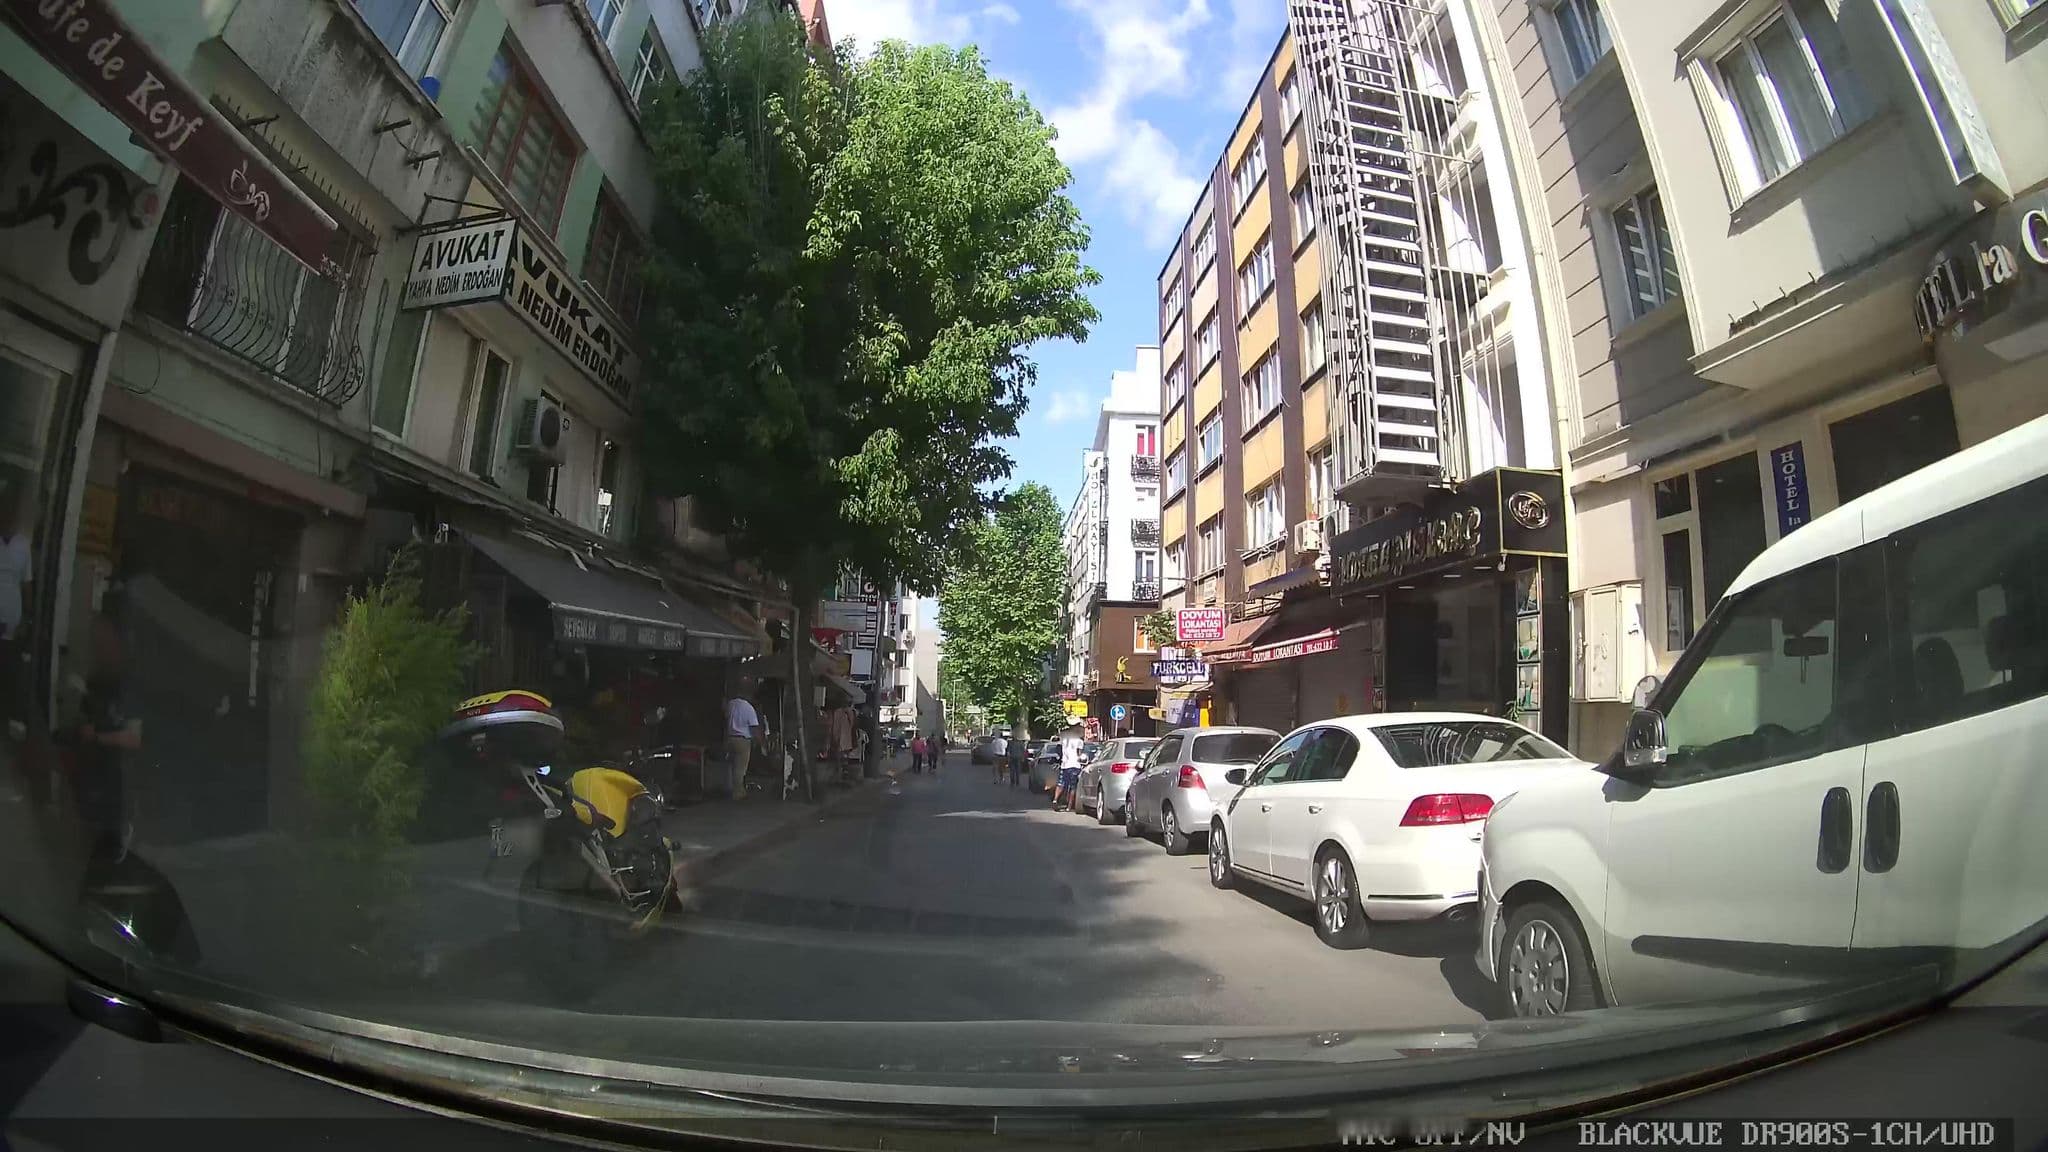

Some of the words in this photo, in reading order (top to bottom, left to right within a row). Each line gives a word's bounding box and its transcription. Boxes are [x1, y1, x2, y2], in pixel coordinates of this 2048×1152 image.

[38, 0, 89, 43] afe
[88, 32, 124, 80] de
[126, 71, 203, 151] Keyf
[419, 229, 505, 273] AVUKAT
[408, 278, 432, 299] YAHYA
[435, 271, 460, 296] NEDİM
[462, 264, 503, 292] ERDOĞAN
[513, 237, 631, 366] VUKAT
[517, 280, 573, 348] NEDİM
[1780, 449, 1800, 511] HOTEL
[1181, 610, 1221, 620] DOYUM
[1181, 619, 1221, 629] LOKANTASI
[1153, 661, 1205, 674] TURKCELL
[1274, 643, 1303, 660] LOKANTASI
